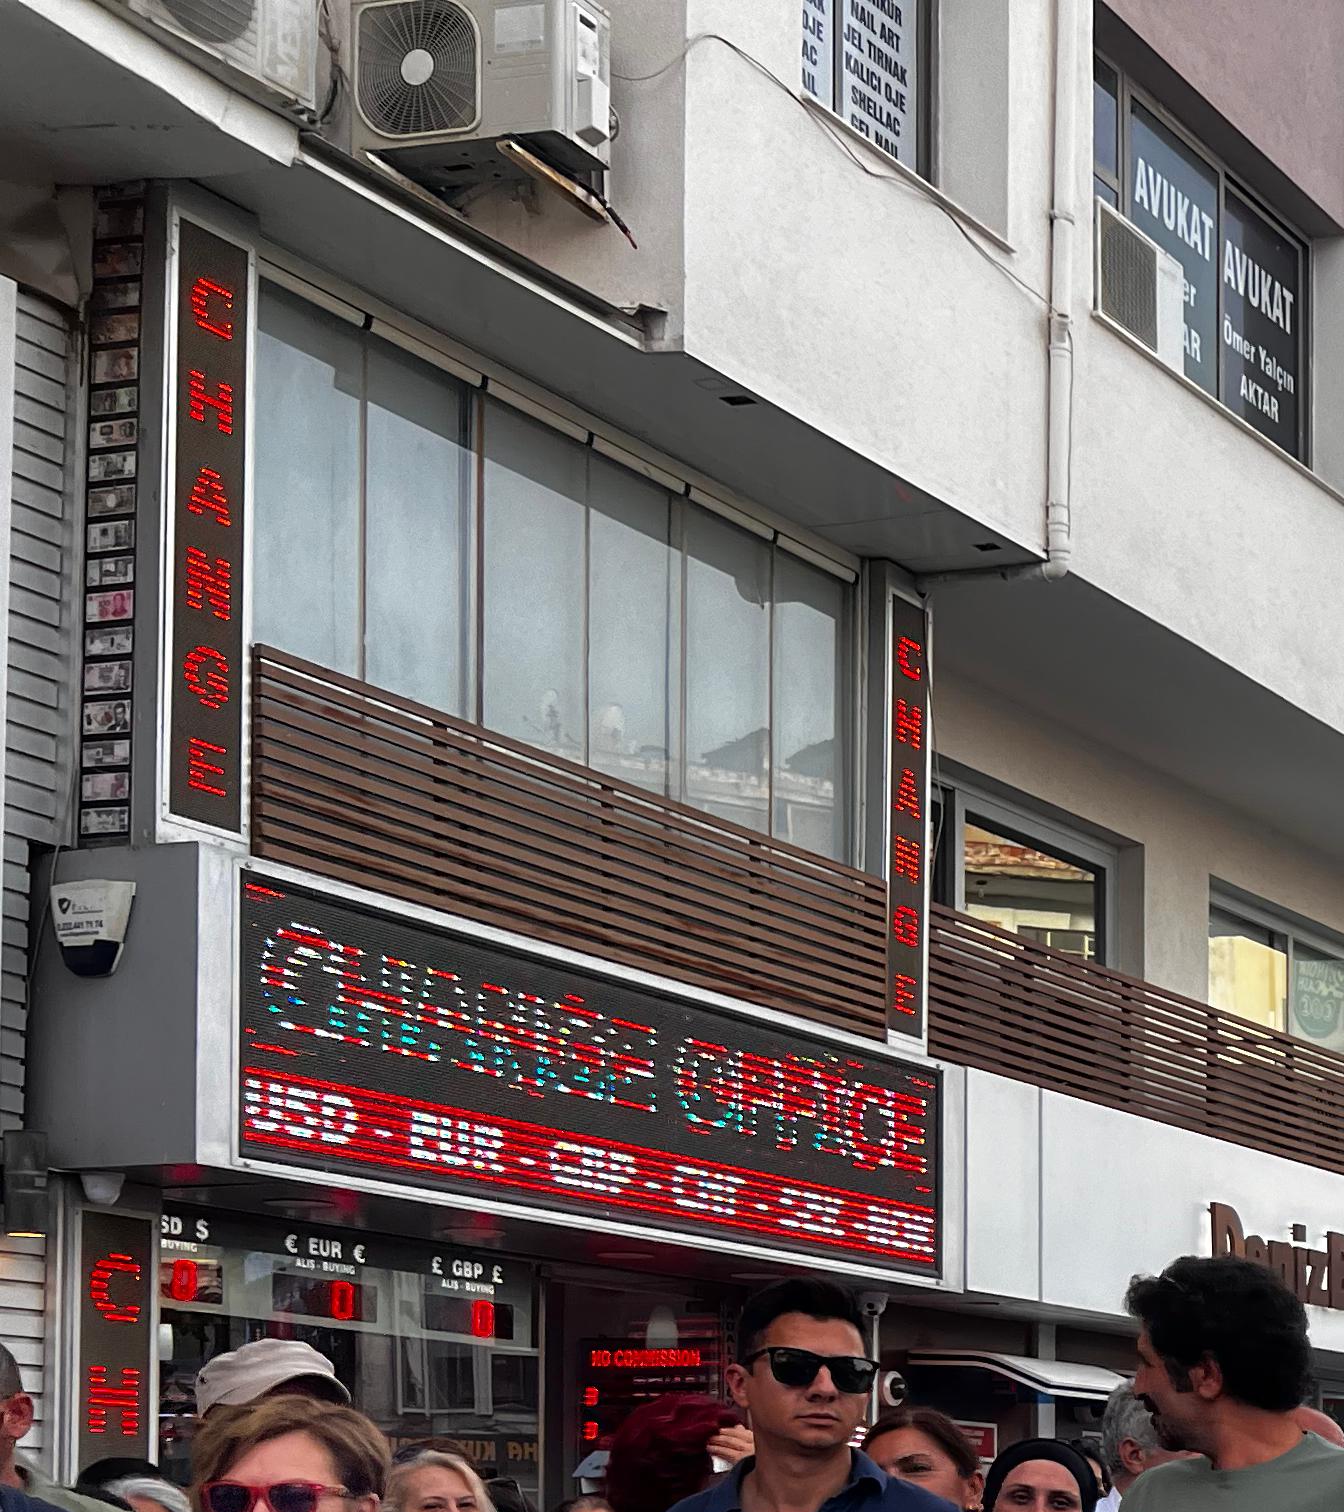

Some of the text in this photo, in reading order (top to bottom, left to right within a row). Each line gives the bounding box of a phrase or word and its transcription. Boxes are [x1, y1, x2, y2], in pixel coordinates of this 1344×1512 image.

[851, 1, 877, 35] NAIL
[880, 22, 900, 53] ART
[844, 23, 908, 88] JEL TIRNAK
[845, 51, 881, 95] KALICI
[851, 84, 900, 138] SHELLAC
[1134, 157, 1214, 262] AVUKAT
[1223, 239, 1295, 336] AVUKAT
[1223, 313, 1257, 365] Ömer
[1258, 345, 1294, 395] Yalçın
[1240, 373, 1279, 424] AKTAR
[161, 1238, 198, 1253] BUYING
[195, 1218, 210, 1242] $
[284, 1234, 366, 1264] € EUR €
[322, 1261, 356, 1276] BUYING
[431, 1256, 504, 1284] £ GBP £
[465, 1281, 495, 1296] BUYING
